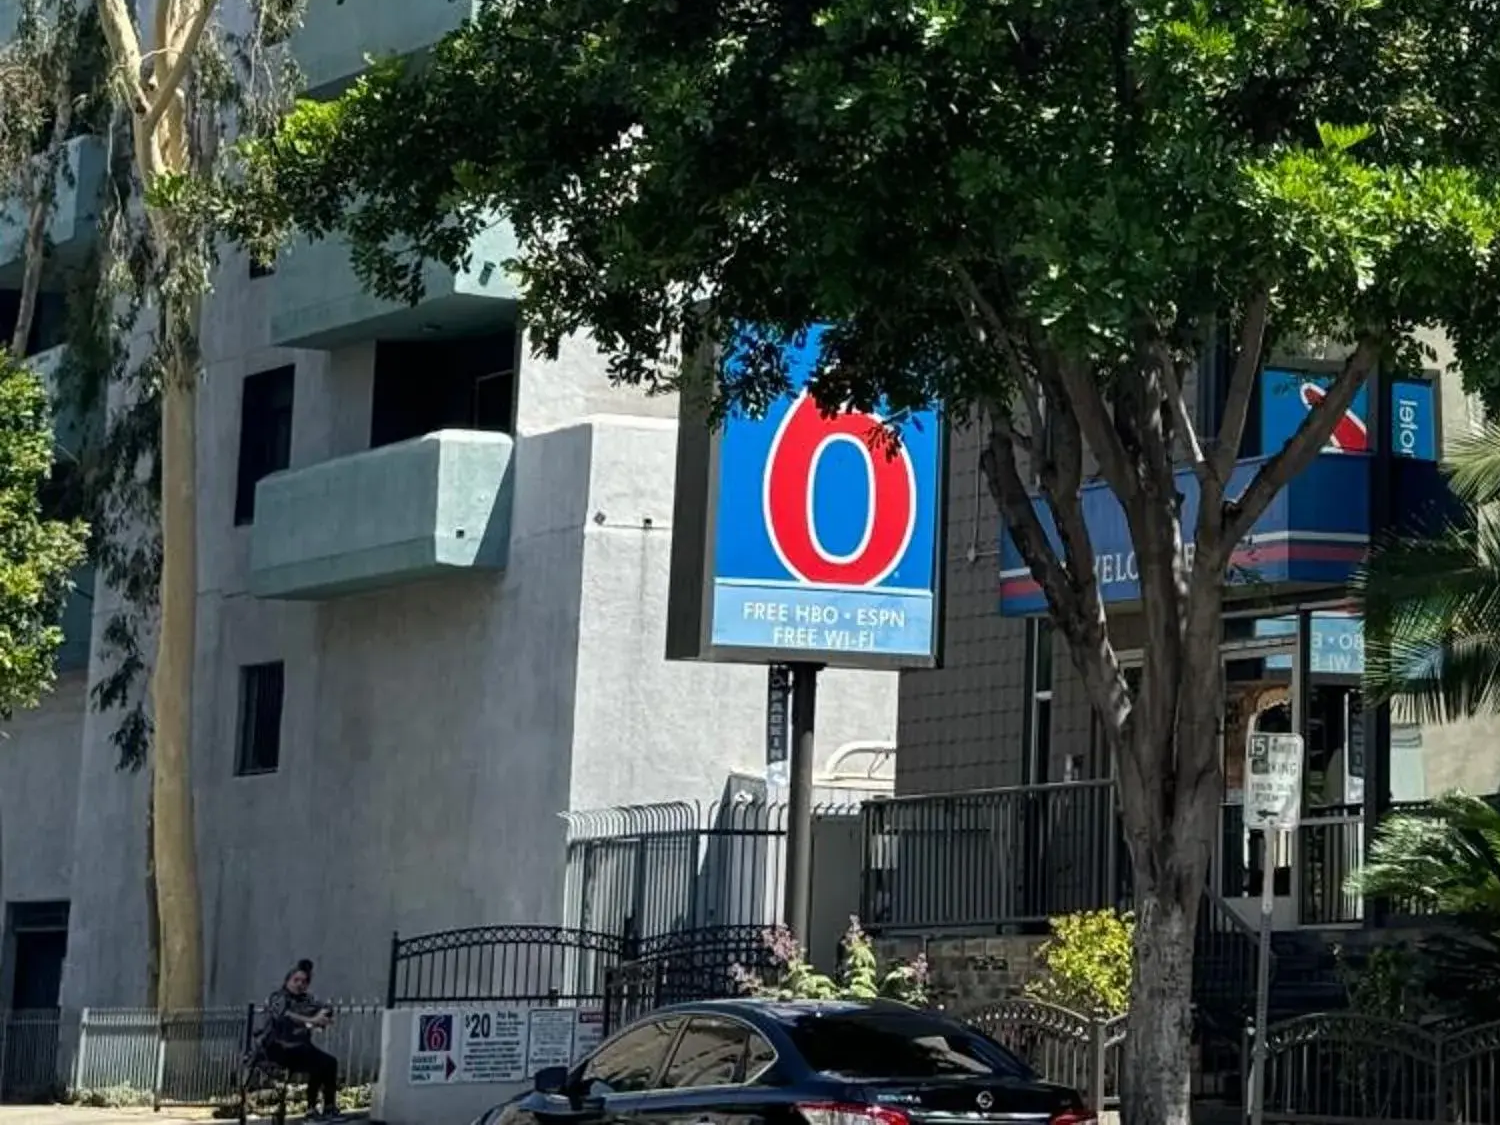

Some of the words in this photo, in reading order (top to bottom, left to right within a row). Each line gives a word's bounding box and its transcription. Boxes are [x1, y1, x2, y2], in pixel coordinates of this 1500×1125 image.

[743, 602, 789, 622] FREE
[796, 604, 839, 625] HBO
[856, 608, 905, 628] ESPN
[773, 627, 818, 647] FREE
[824, 629, 875, 650] WI-FI
